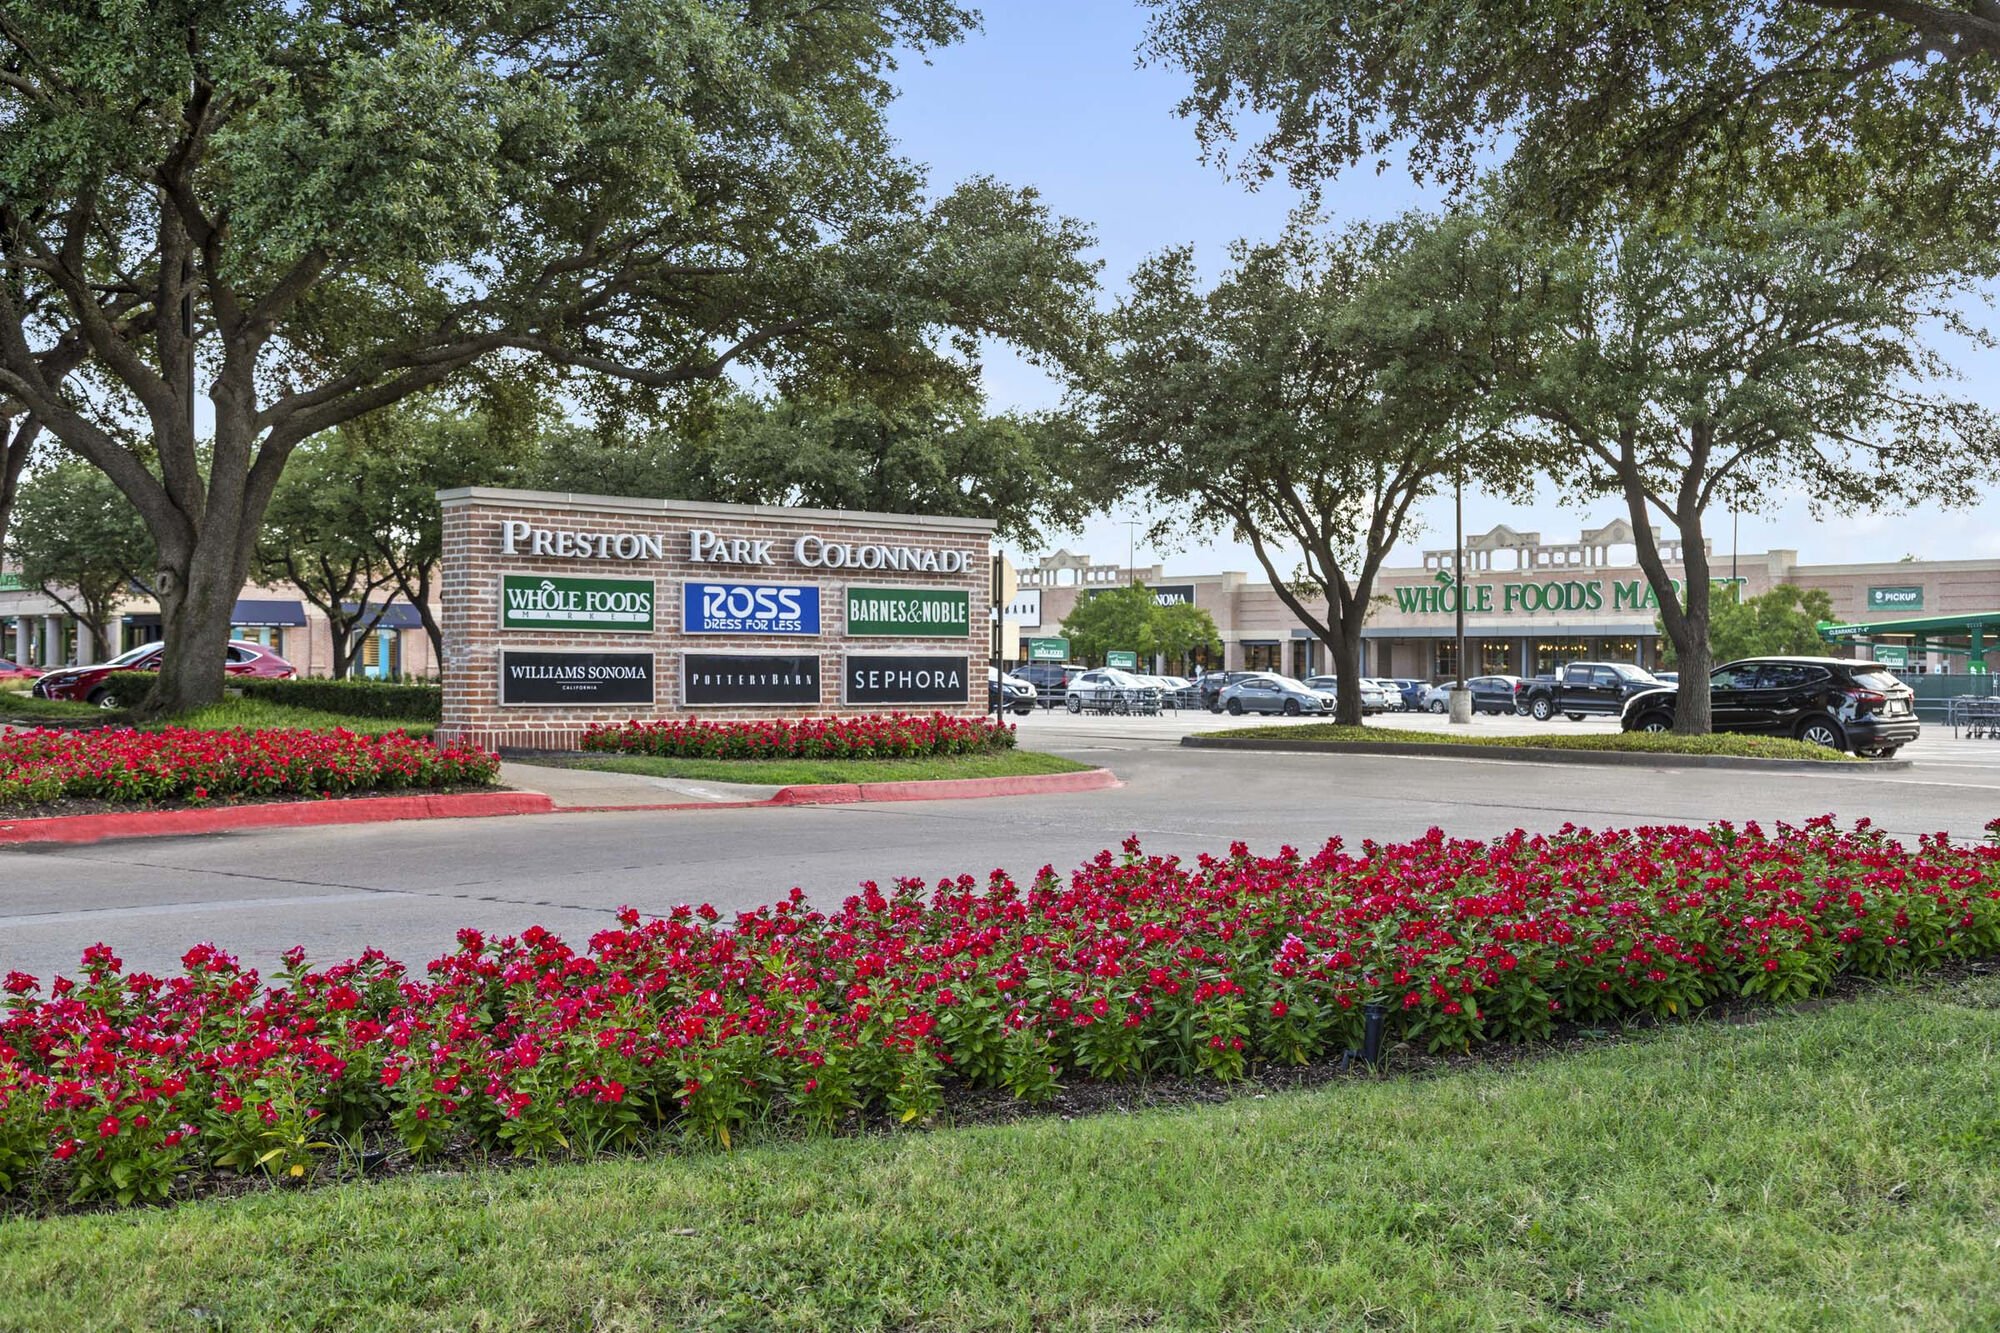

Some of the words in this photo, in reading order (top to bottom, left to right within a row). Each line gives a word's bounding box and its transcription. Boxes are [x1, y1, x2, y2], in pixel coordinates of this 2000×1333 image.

[500, 520, 665, 560] PRESTON
[688, 529, 776, 565] PARK
[794, 535, 977, 574] COLONNADE
[506, 587, 582, 610] WHOLE
[585, 591, 651, 612] FOODS
[703, 586, 801, 620] ROSS
[1394, 583, 1494, 614] WHOLE
[1503, 580, 1604, 613] FOODS
[1885, 592, 1917, 601] PICKUP
[522, 611, 638, 621] MARKET
[704, 619, 742, 630] DRESS
[746, 619, 768, 631] FOR
[772, 620, 801, 631] LESS
[1829, 627, 1857, 636] CLEARANCE
[510, 666, 585, 679] WILLIAMS
[588, 667, 647, 679] SONOMA
[855, 671, 960, 689] SEPHORA
